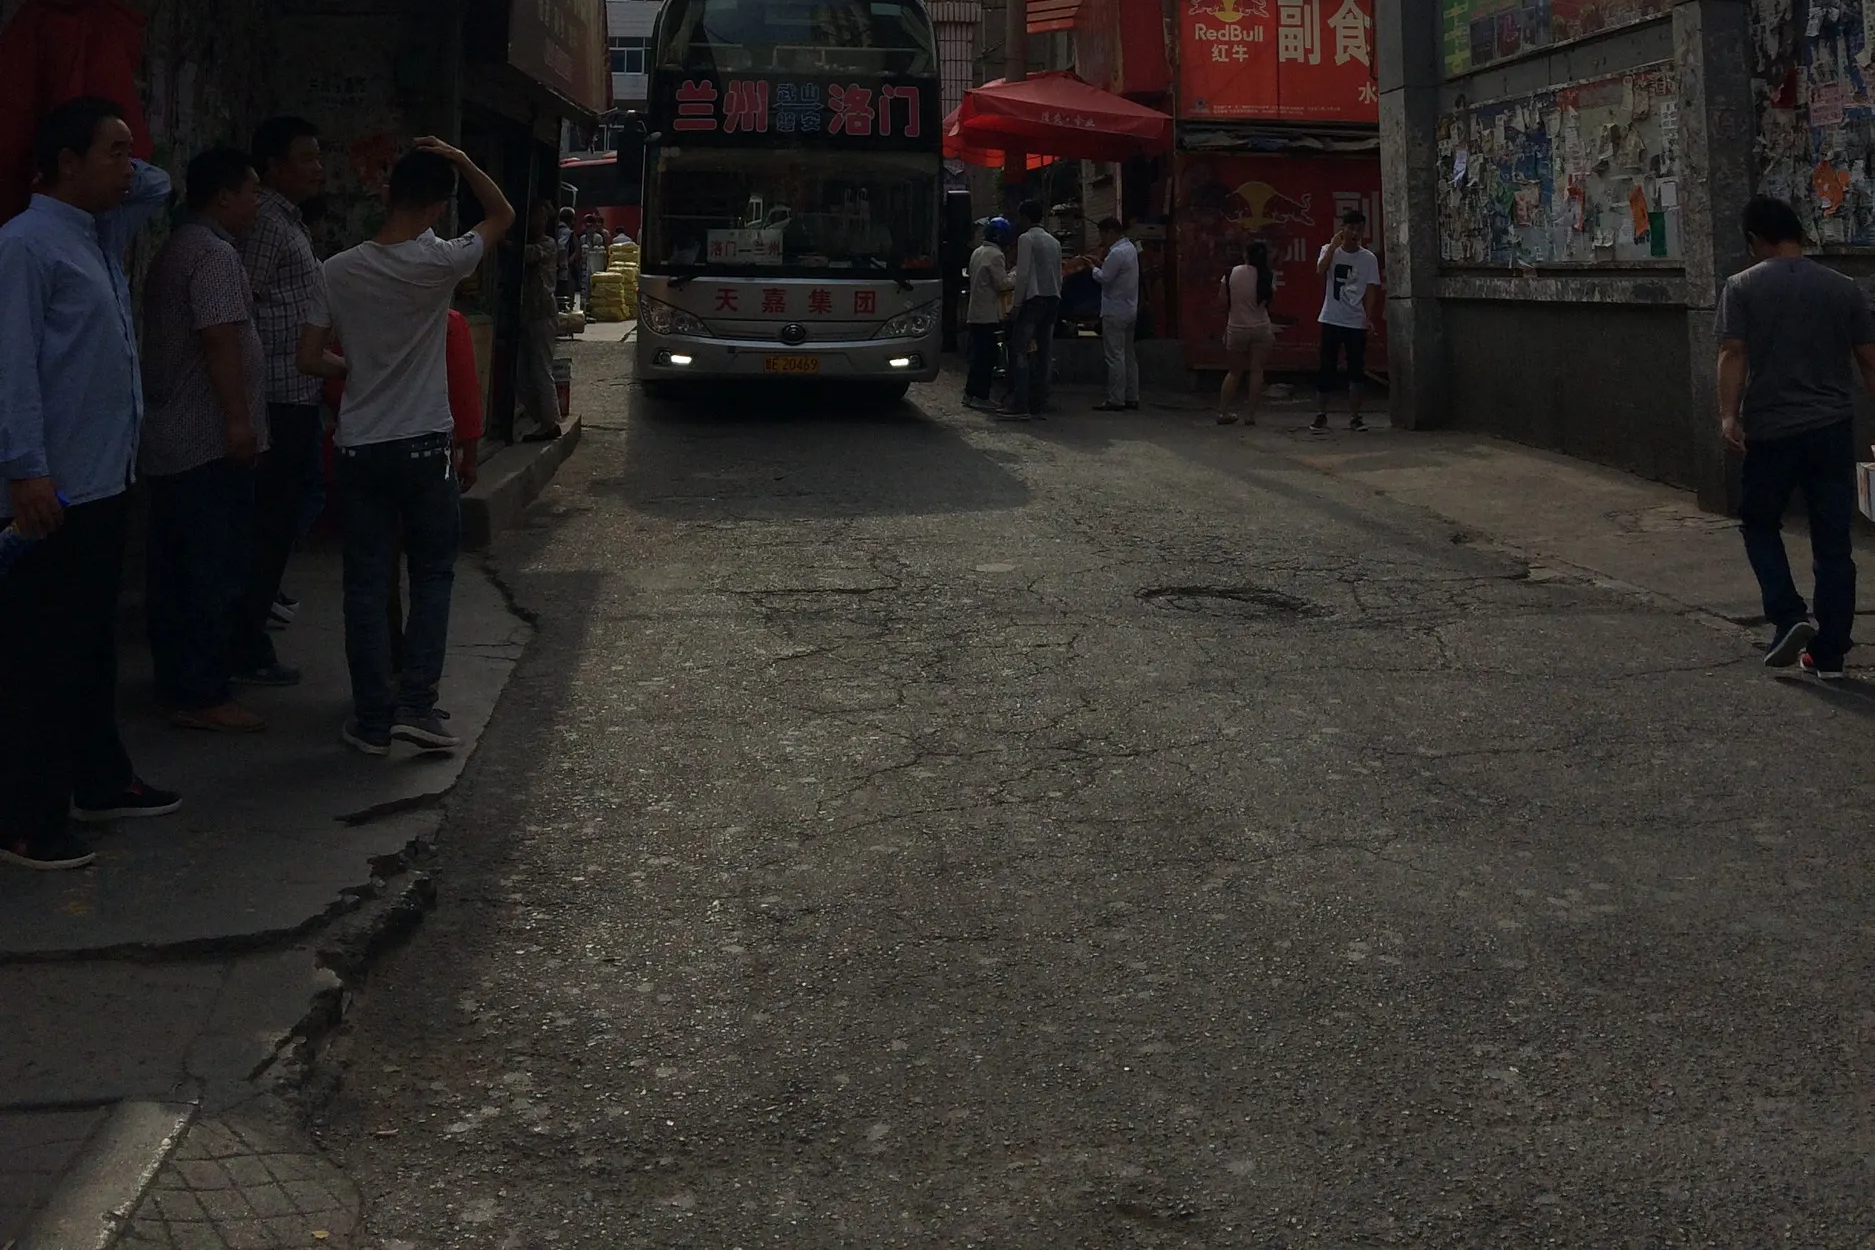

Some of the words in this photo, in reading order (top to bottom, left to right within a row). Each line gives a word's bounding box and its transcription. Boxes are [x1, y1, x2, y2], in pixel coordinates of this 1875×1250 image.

[1194, 23, 1264, 42] RedBull
[1211, 44, 1249, 63] 红牛
[673, 79, 768, 134] 兰州
[828, 83, 920, 137] 洛门
[715, 288, 876, 314] 天嘉集团
